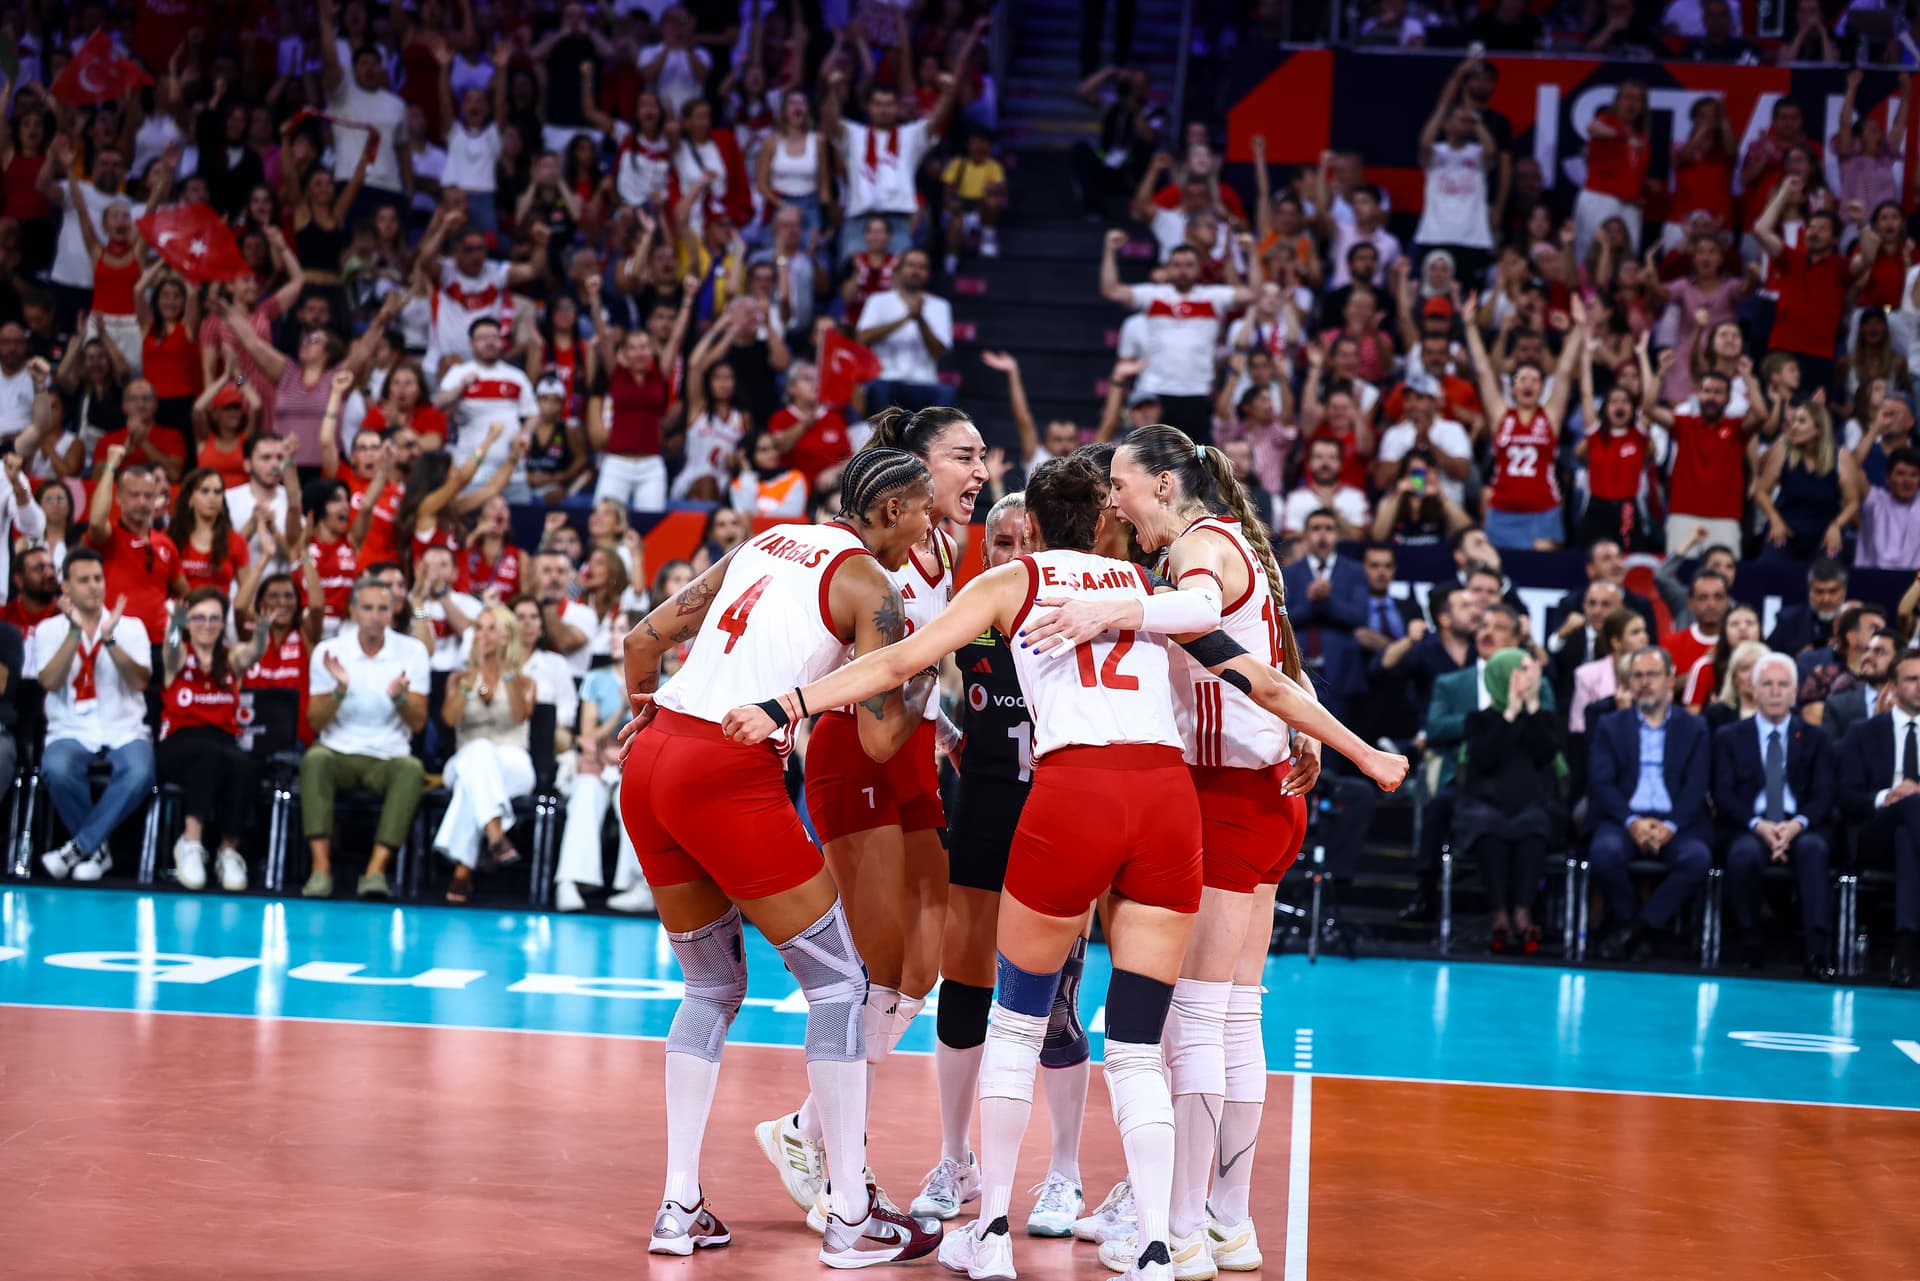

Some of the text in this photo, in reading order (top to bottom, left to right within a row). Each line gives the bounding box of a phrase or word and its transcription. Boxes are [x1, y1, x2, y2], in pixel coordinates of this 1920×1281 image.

[1506, 446, 1538, 477] 22
[717, 575, 774, 654] 4
[1075, 629, 1139, 691] 12
[1008, 721, 1030, 782] 1
[861, 786, 876, 809] 7
